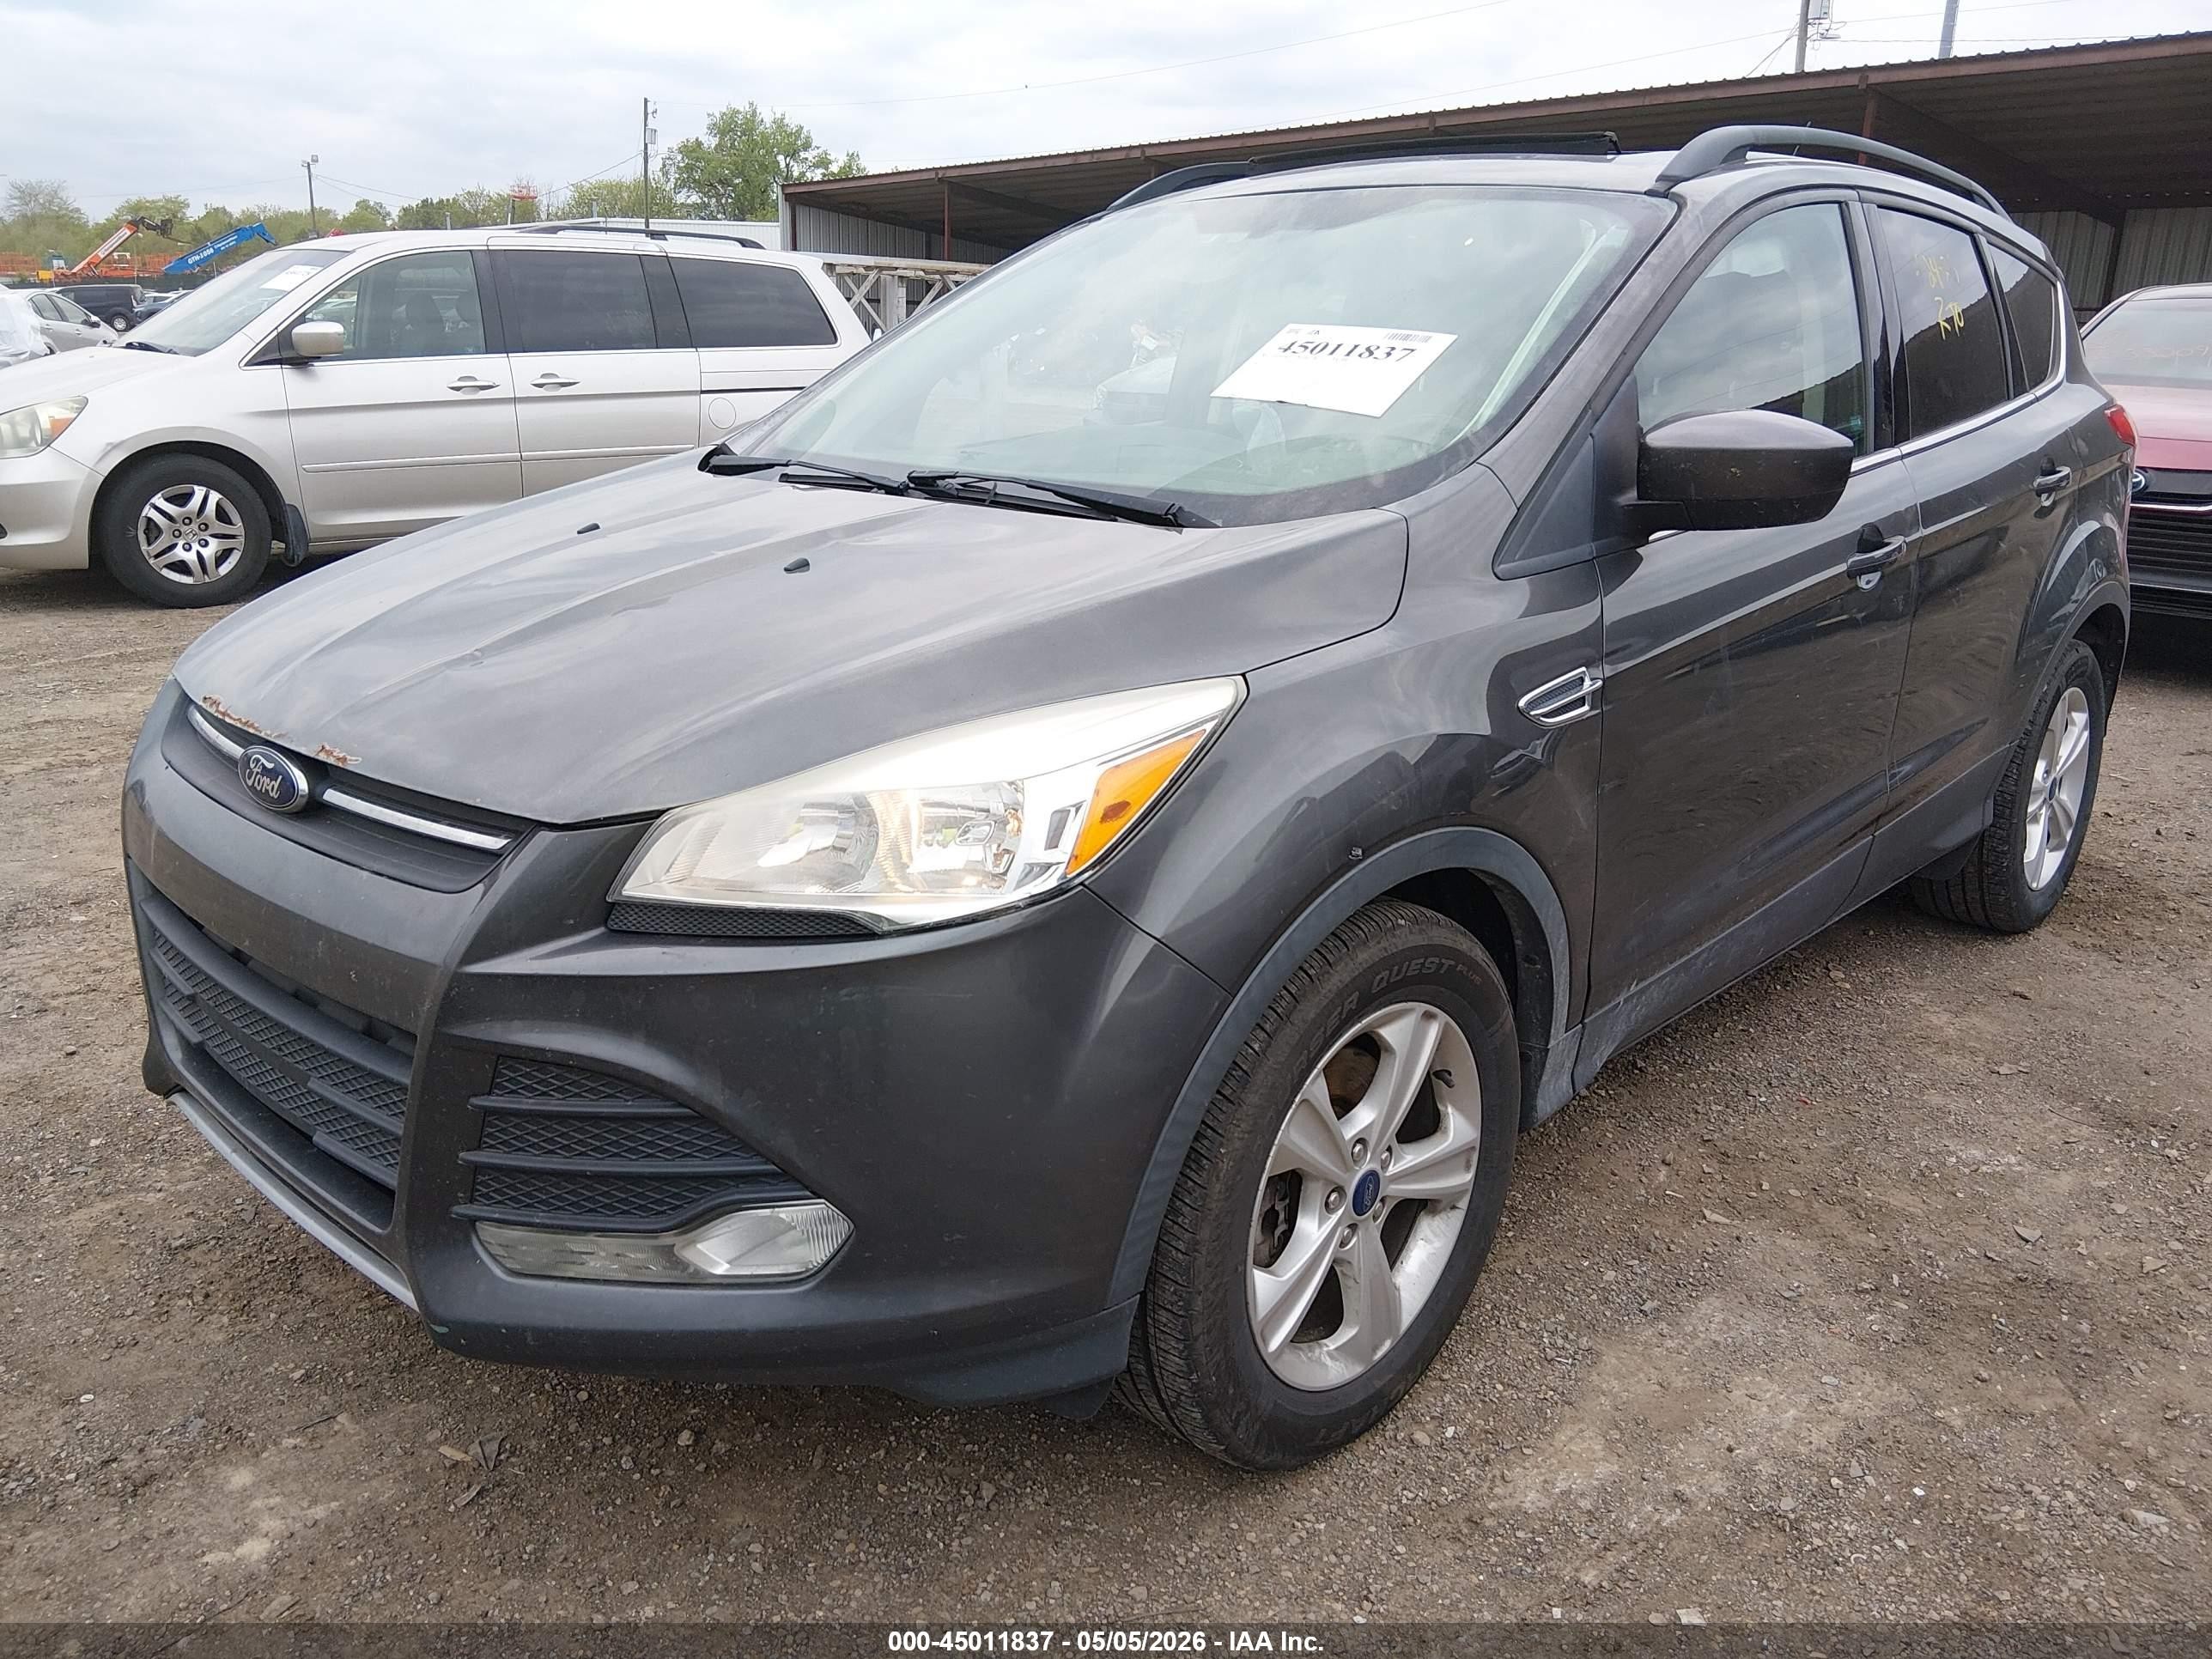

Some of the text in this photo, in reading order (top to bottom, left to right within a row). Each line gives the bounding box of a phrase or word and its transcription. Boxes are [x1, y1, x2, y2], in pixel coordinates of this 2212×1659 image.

[1278, 340, 1417, 362] 45011837
[246, 754, 283, 799] Ford
[1371, 957, 1455, 994] QUEST
